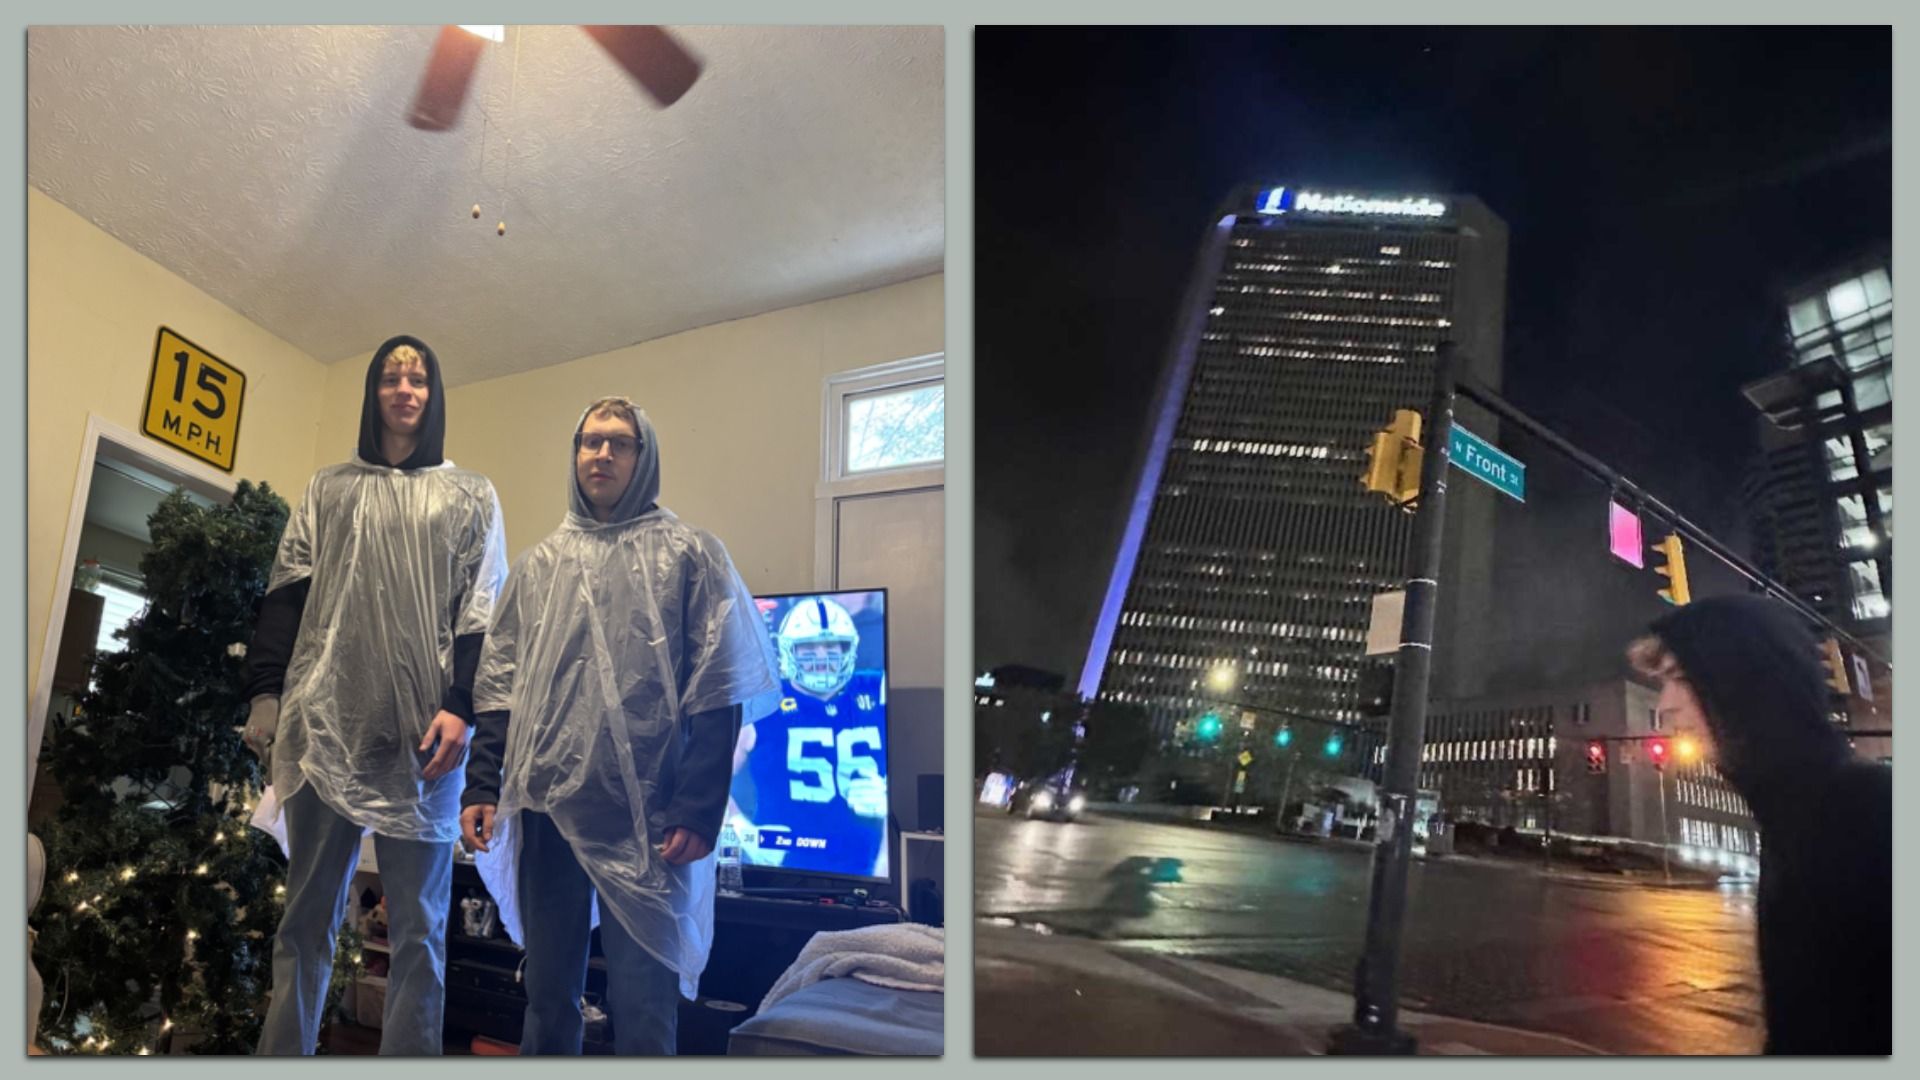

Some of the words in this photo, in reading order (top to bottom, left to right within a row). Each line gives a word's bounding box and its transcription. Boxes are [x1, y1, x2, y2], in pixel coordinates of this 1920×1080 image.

[1295, 192, 1446, 217] Nationwide
[173, 351, 227, 419] 15
[162, 408, 222, 456] M.P.H.
[1455, 440, 1463, 453] N
[1465, 443, 1507, 482] Front
[787, 726, 882, 803] 56
[796, 836, 827, 849] DOWN
